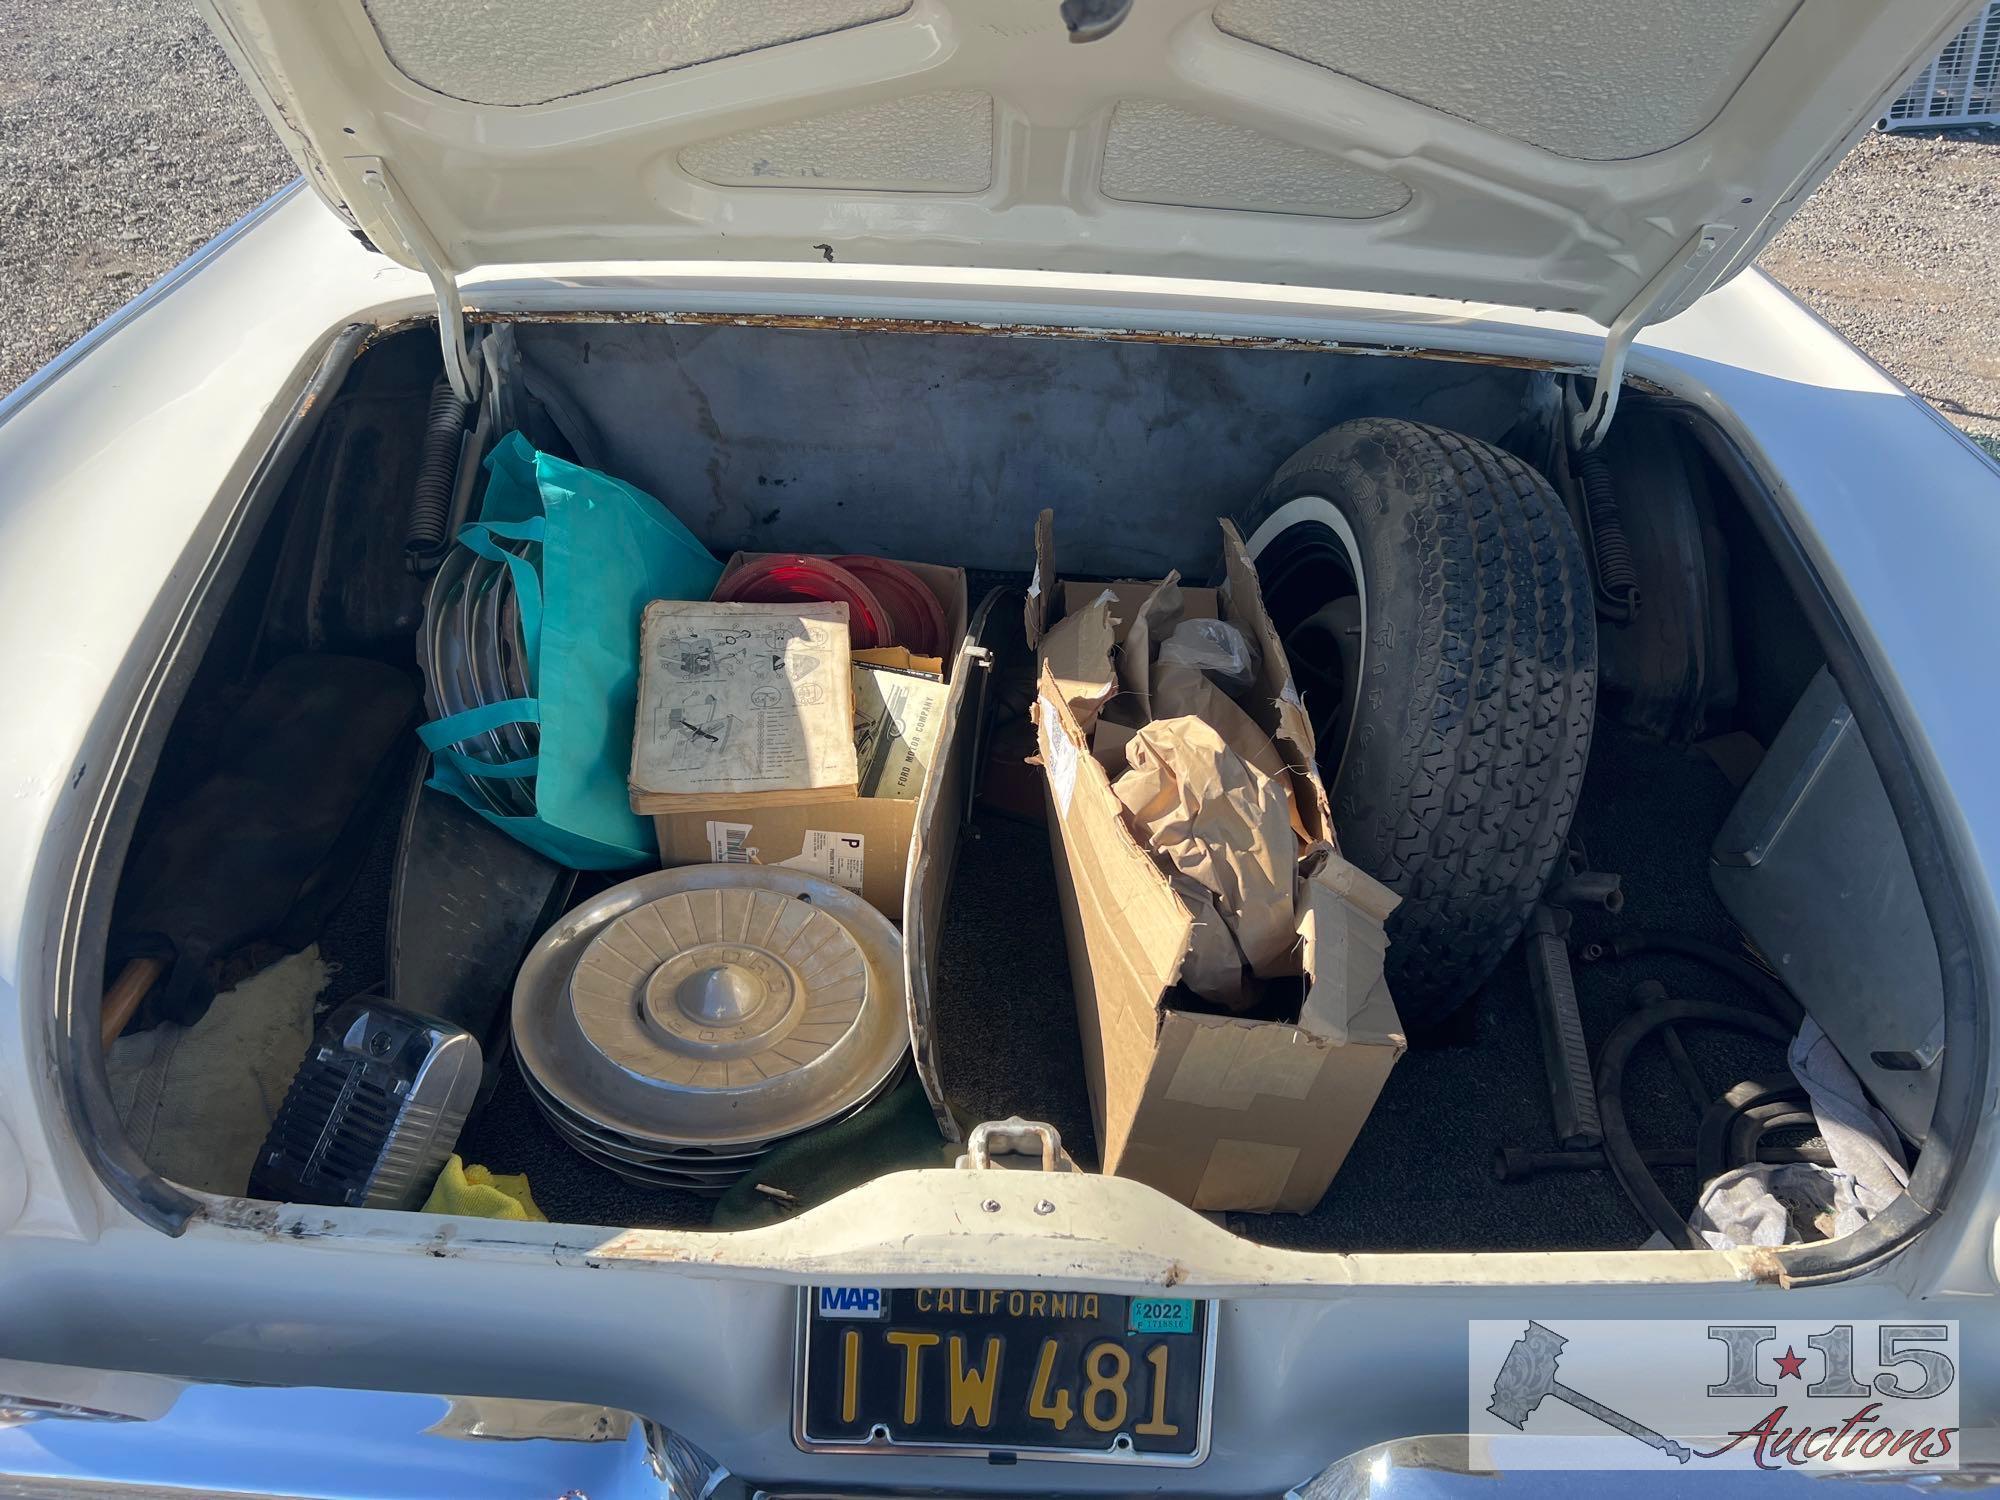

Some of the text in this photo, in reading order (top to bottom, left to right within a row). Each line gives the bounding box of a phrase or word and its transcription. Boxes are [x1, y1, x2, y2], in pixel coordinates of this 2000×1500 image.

[898, 696, 934, 787] FORD MOTOR COMPANY
[821, 1287, 880, 1311] MAR
[916, 1287, 1099, 1319] CALIFORNIA
[1143, 1303, 1182, 1319] 2022
[1028, 1336, 1180, 1436] 481
